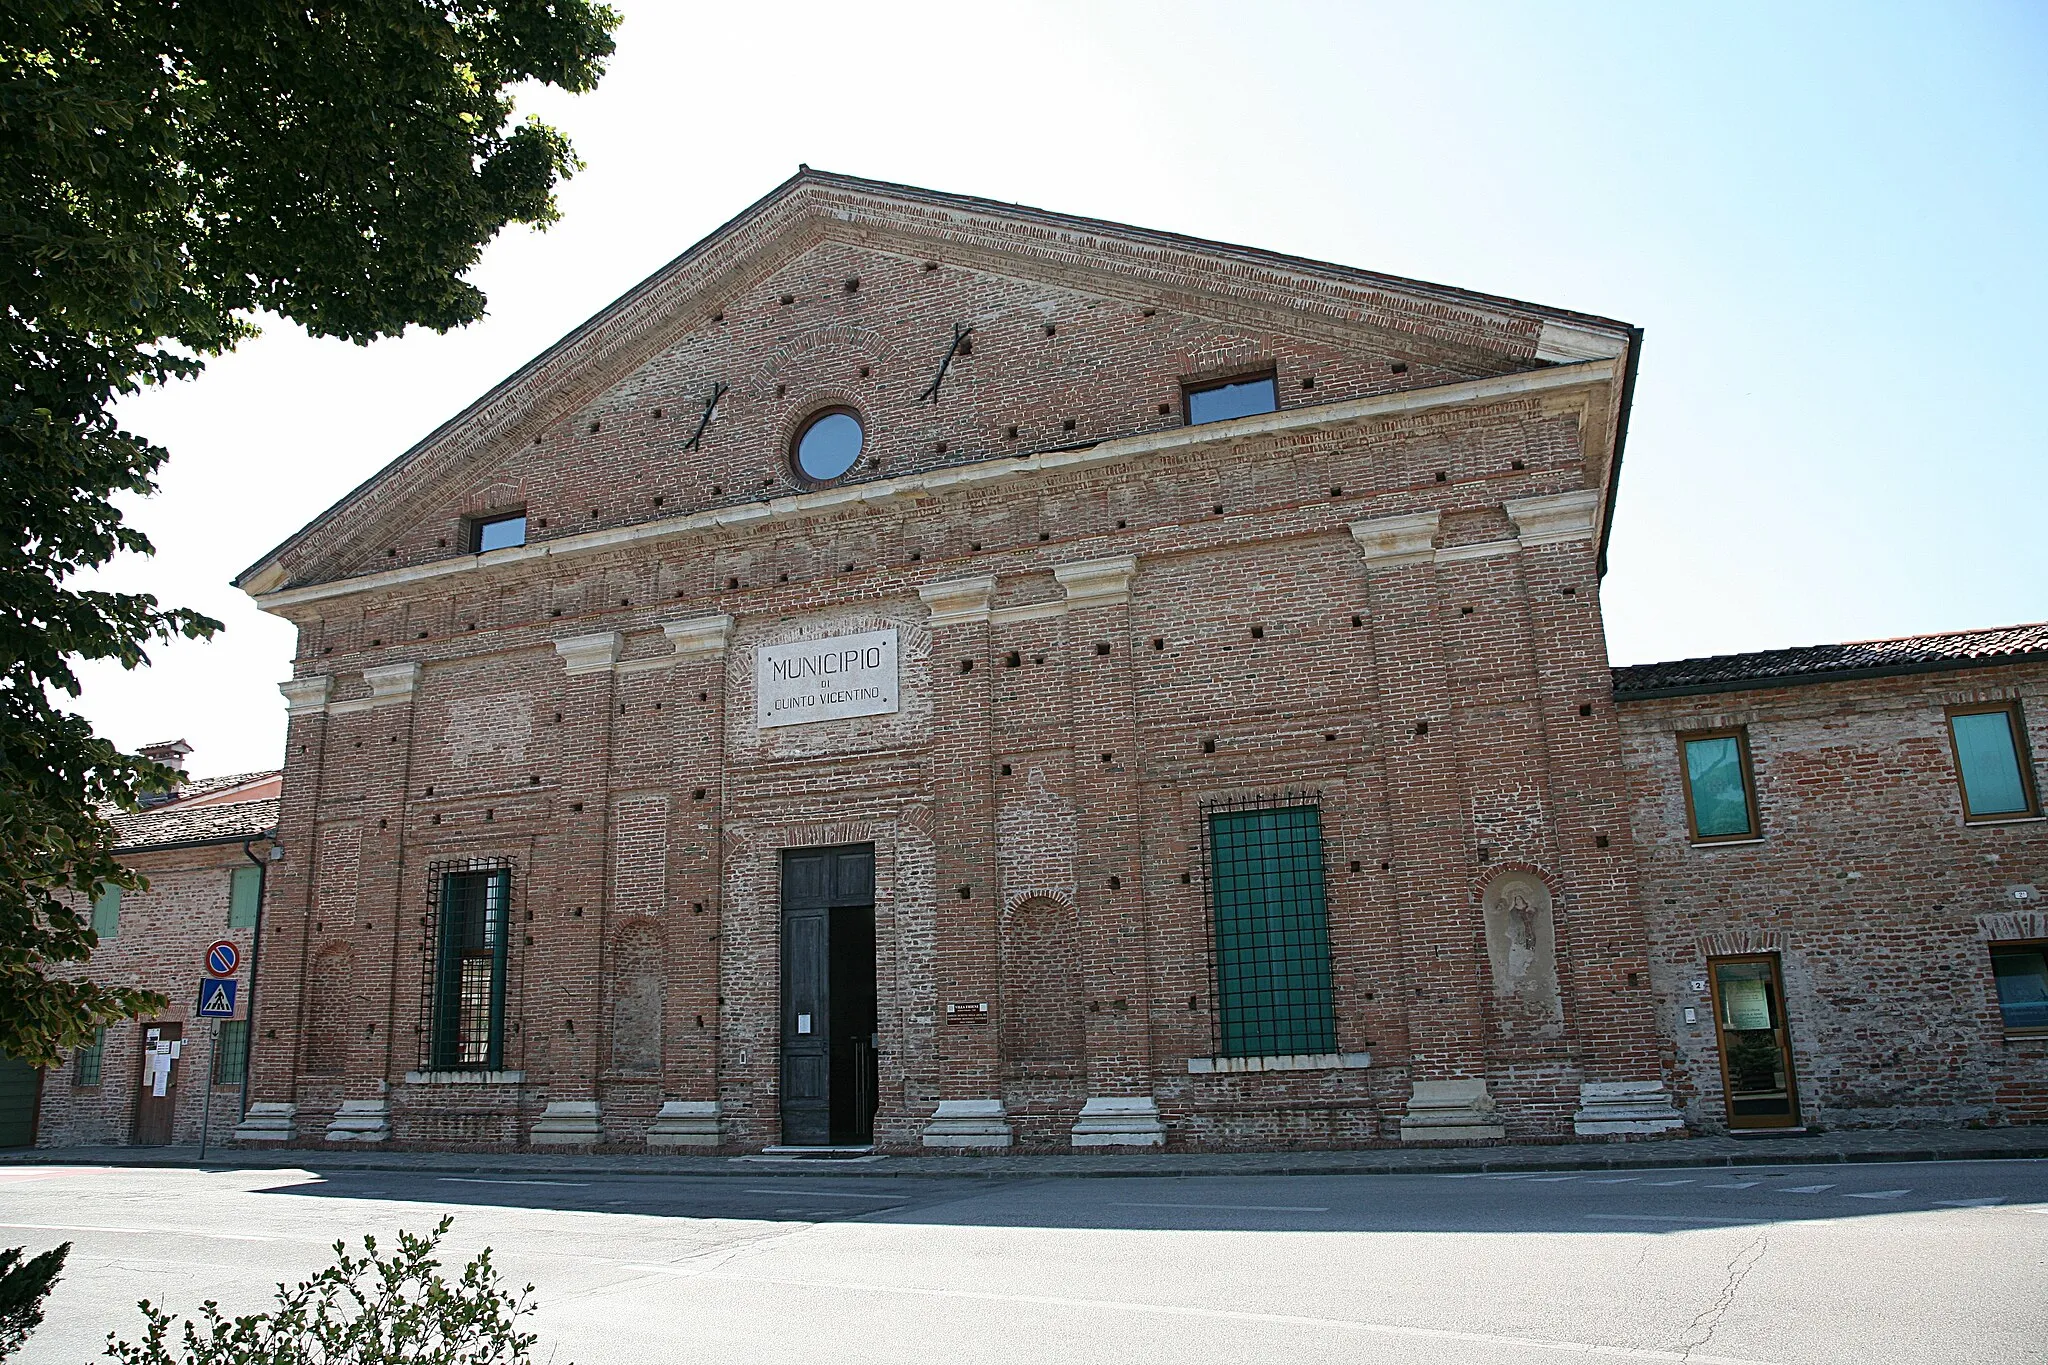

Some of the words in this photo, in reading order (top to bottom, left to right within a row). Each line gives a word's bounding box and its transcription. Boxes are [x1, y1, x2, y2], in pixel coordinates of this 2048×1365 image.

[773, 647, 880, 681] MUNICIPIO
[821, 680, 830, 688] DI
[820, 687, 879, 704] VICENTINO
